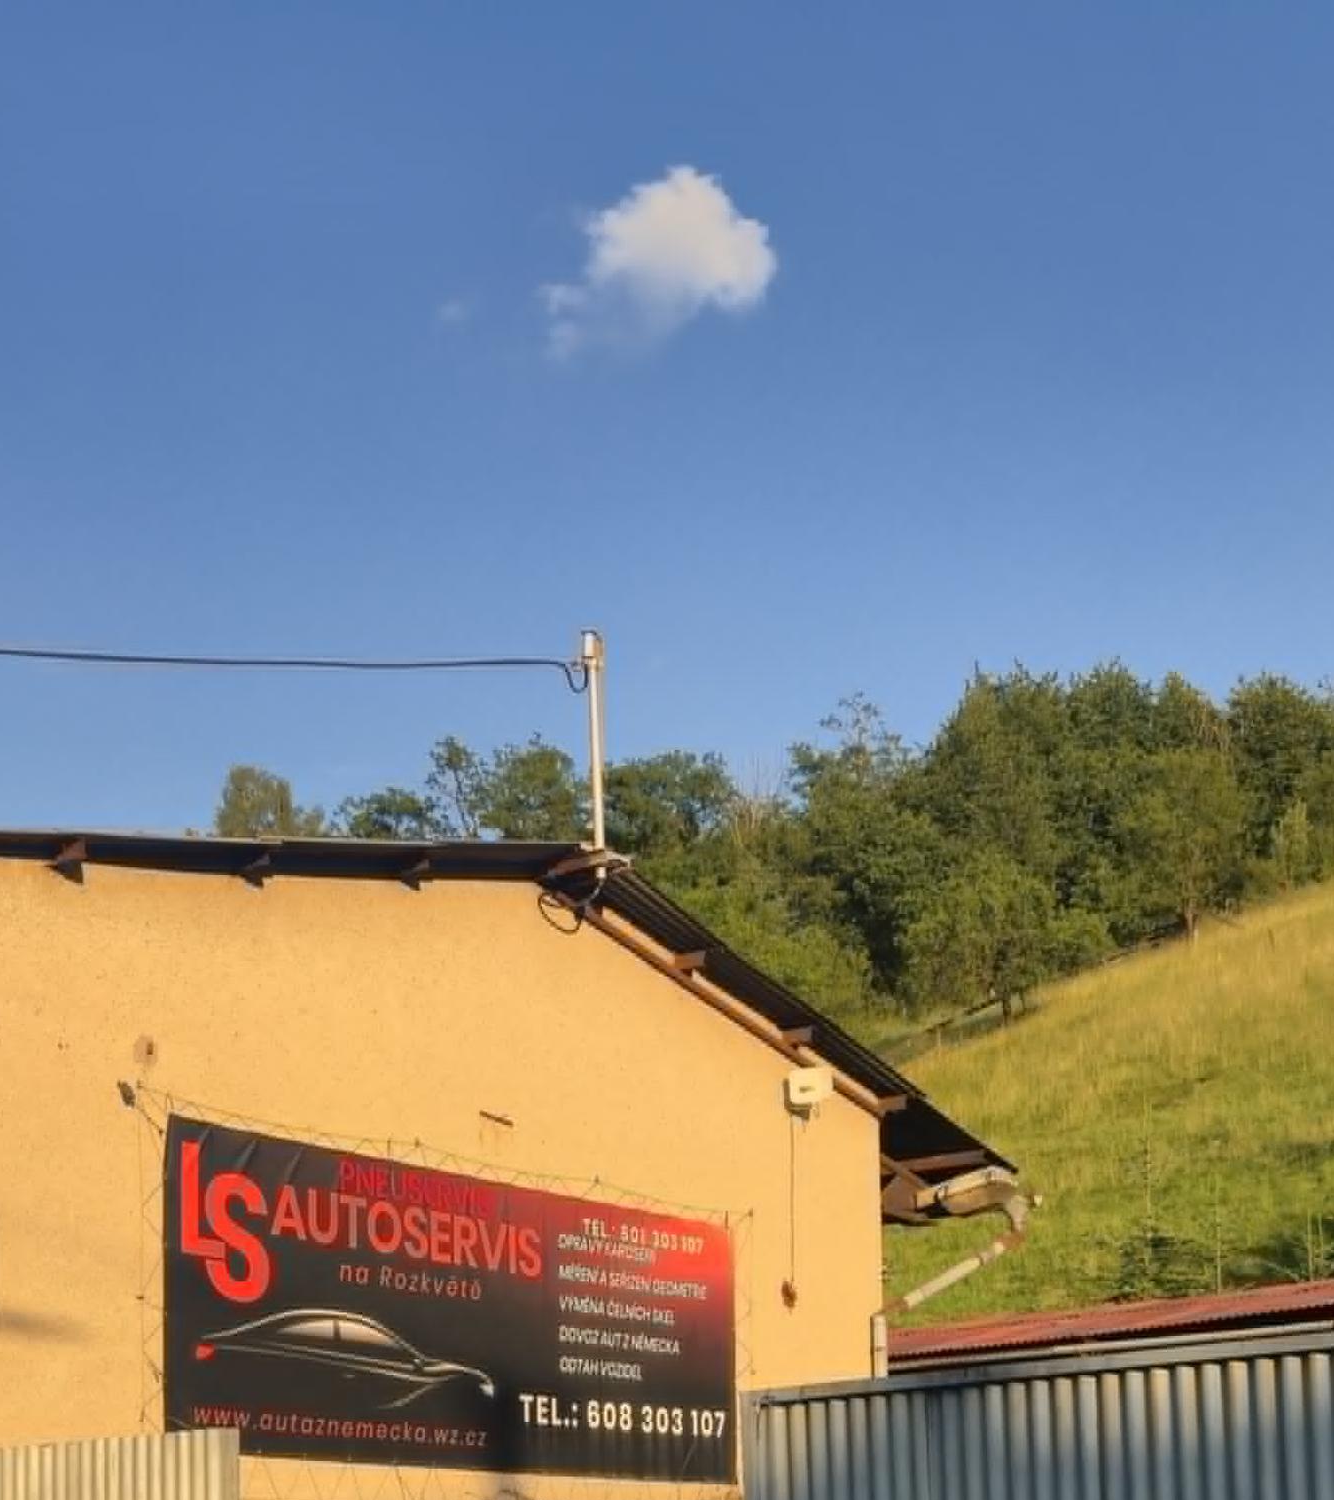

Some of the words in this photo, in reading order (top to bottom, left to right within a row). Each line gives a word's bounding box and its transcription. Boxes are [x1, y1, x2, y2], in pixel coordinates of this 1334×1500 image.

[270, 1185, 542, 1277] AUTOSERVIS
[339, 1264, 369, 1285] na
[192, 1404, 489, 1447] www.autaznemecka.wz.cz
[518, 1393, 579, 1429] TEL.:
[587, 1399, 633, 1432] 608
[641, 1405, 684, 1435] 303
[690, 1409, 726, 1439] 107
